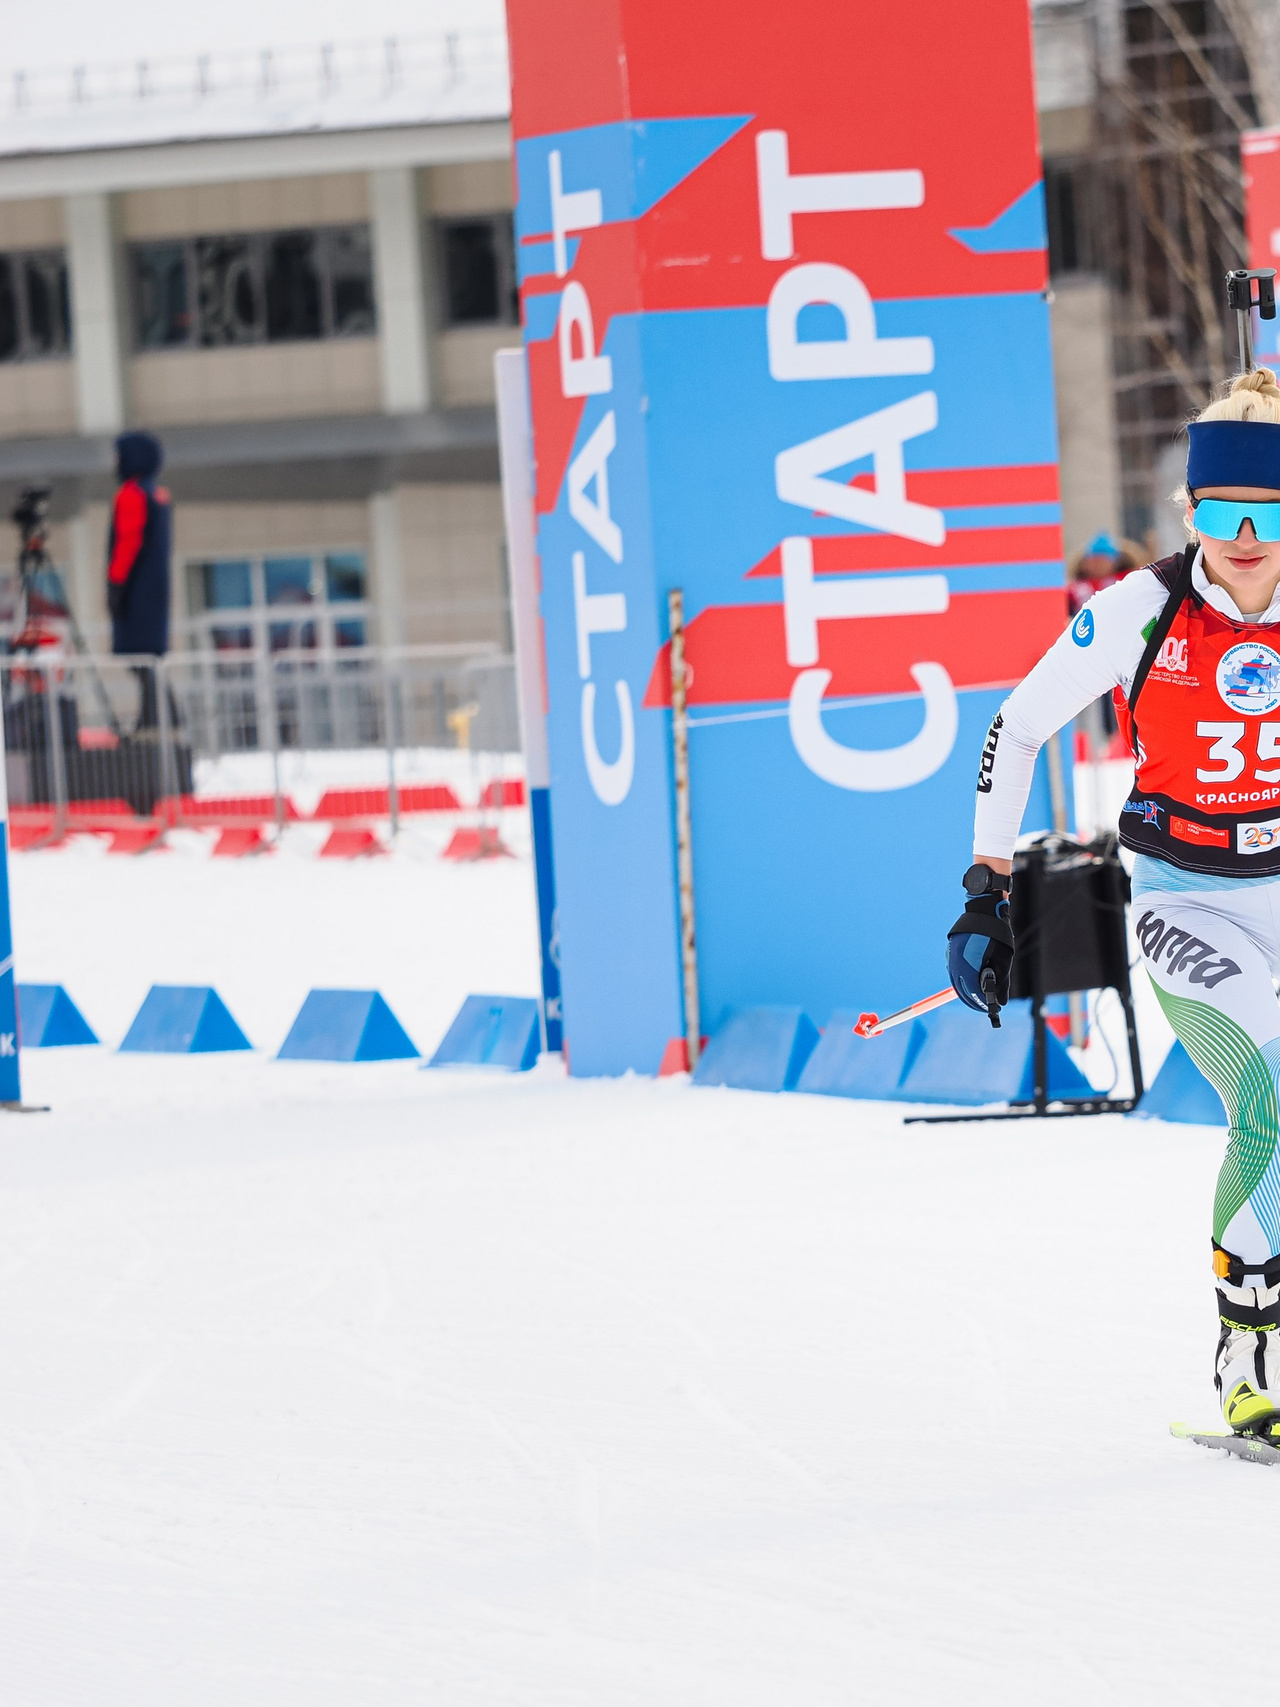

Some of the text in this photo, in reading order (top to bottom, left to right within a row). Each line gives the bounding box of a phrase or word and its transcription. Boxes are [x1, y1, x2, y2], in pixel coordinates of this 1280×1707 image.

[548, 149, 635, 806] СТАРТ
[755, 129, 959, 792] СТАРТ
[1222, 643, 1259, 664] ПЕРВЕНСТВО
[1220, 1314, 1277, 1333] FISCHER
